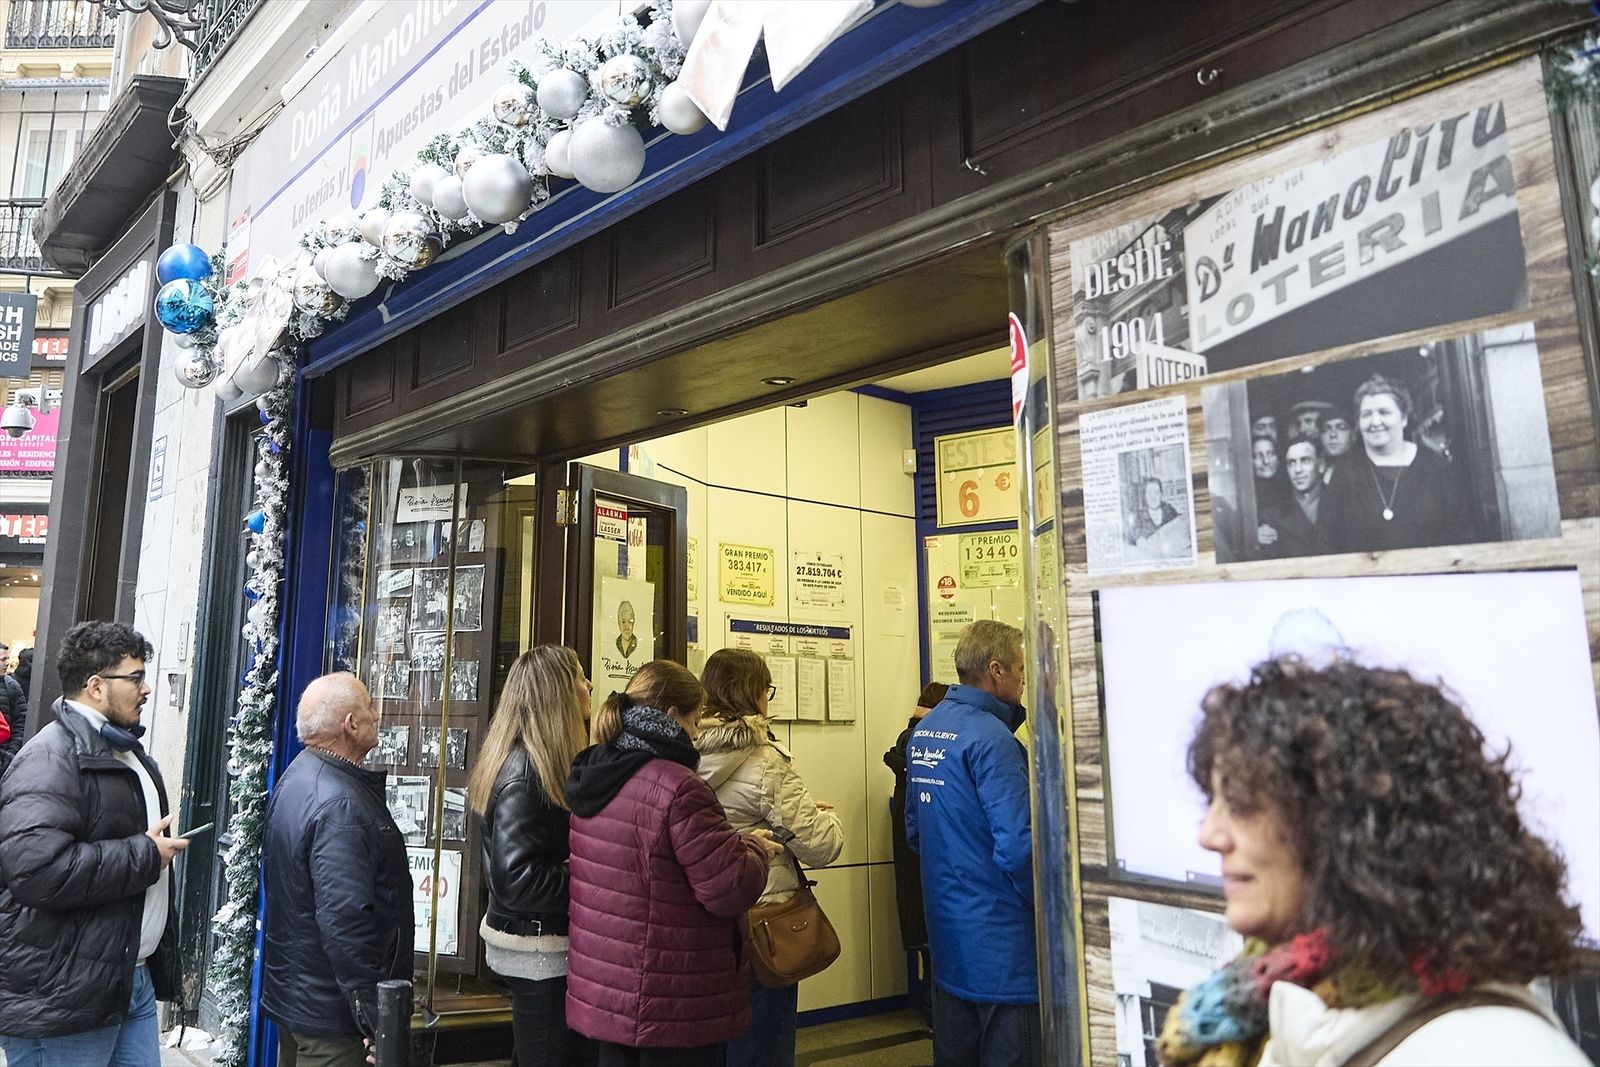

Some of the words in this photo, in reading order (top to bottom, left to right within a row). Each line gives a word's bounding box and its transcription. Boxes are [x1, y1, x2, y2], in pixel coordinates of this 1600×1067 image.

[292, 177, 337, 229] Loterías
[337, 166, 347, 198] y
[375, 86, 444, 161] Apuestas
[450, 49, 474, 100] del
[479, 0, 546, 75] Estado
[290, 82, 341, 162] Doña
[1198, 154, 1516, 340] LOTERIA
[1084, 240, 1174, 300] DESDE
[1100, 312, 1165, 362] 1904
[959, 480, 980, 517] 6
[995, 472, 1011, 491] €
[598, 507, 623, 520] ALARMA
[601, 526, 622, 534] LASSER
[978, 534, 1011, 545] PREMIO
[724, 548, 744, 558] GRAN
[744, 551, 769, 560] PREMIO
[966, 544, 1018, 560] 13440
[728, 559, 762, 573] 383.417
[796, 566, 836, 578] 27.819.704
[837, 569, 842, 578] €
[940, 577, 953, 586] +18
[726, 588, 752, 597] VENDIDO
[753, 590, 768, 598] AQUÍ
[756, 623, 788, 633] RESULTADOS
[935, 732, 958, 740] CLIENTE
[419, 875, 448, 898] 40
